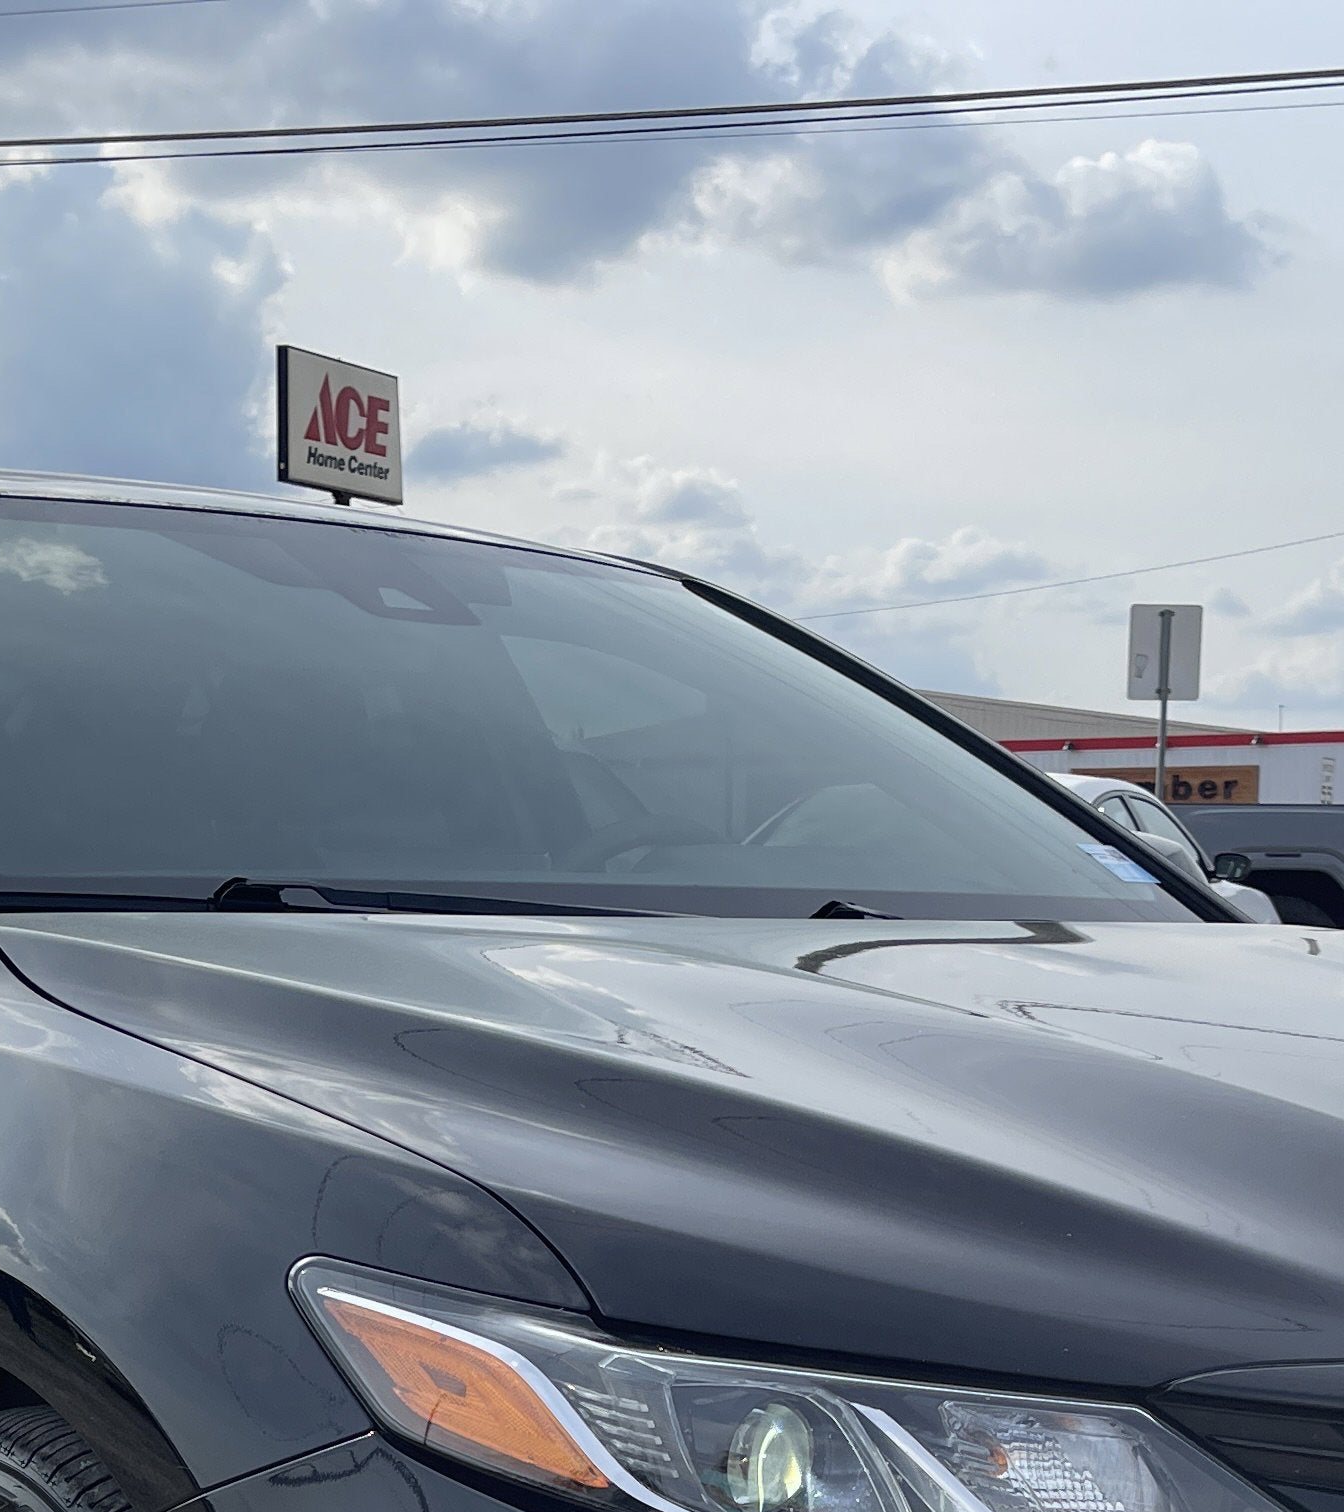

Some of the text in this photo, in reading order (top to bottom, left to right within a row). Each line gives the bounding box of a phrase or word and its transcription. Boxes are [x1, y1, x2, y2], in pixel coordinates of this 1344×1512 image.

[304, 372, 390, 457] ACE
[306, 446, 390, 480] Home Center
[1136, 775, 1238, 800] ber
